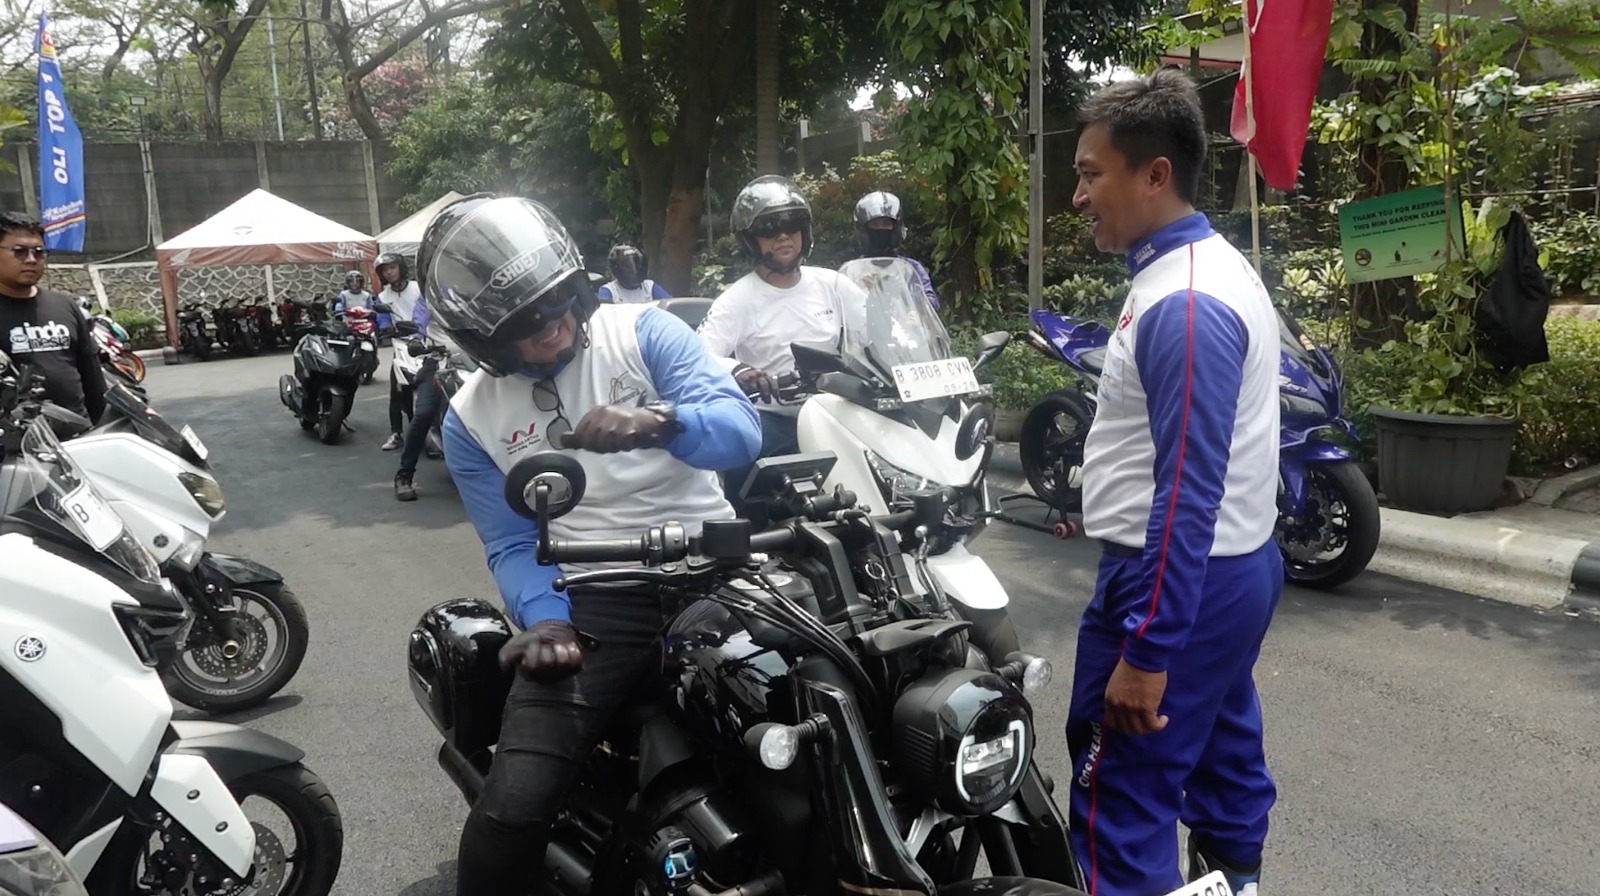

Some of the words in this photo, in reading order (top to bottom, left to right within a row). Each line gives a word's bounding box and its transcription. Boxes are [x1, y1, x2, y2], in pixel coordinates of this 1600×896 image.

[40, 71, 54, 84] 1
[44, 89, 65, 133] TOP
[52, 146, 68, 185] OLI
[1352, 213, 1376, 222] THANK
[1378, 209, 1393, 217] YOU
[1394, 205, 1411, 214] FOR
[1411, 199, 1445, 210] KEEPING
[1353, 223, 1371, 232] THIS
[1371, 219, 1388, 228] MINI
[1389, 213, 1420, 225] GARDEN
[1421, 209, 1446, 219] CLEAN
[495, 252, 536, 286] SHOEI
[23, 320, 70, 341] indo
[895, 369, 904, 383] B
[910, 364, 942, 381] 3808
[71, 503, 90, 523] B
[1078, 762, 1093, 788] One
